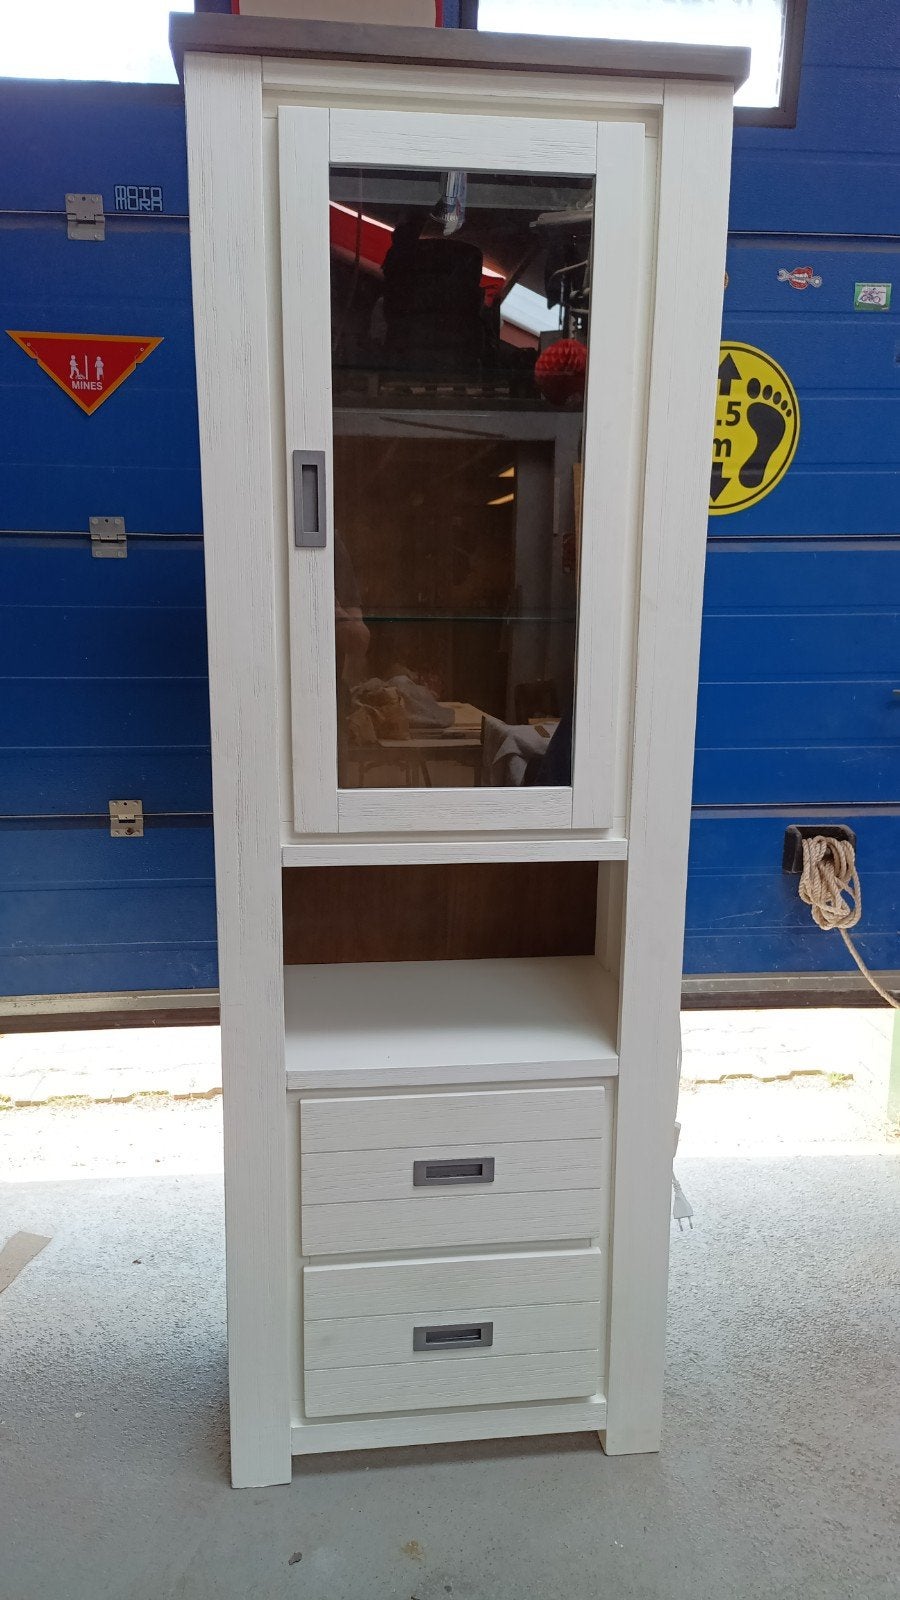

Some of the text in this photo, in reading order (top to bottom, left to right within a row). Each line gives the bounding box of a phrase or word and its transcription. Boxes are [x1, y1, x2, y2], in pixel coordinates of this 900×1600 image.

[114, 185, 162, 199] MOTO
[115, 197, 163, 211] MORA
[71, 380, 103, 391] MINES
[712, 437, 732, 457] m
